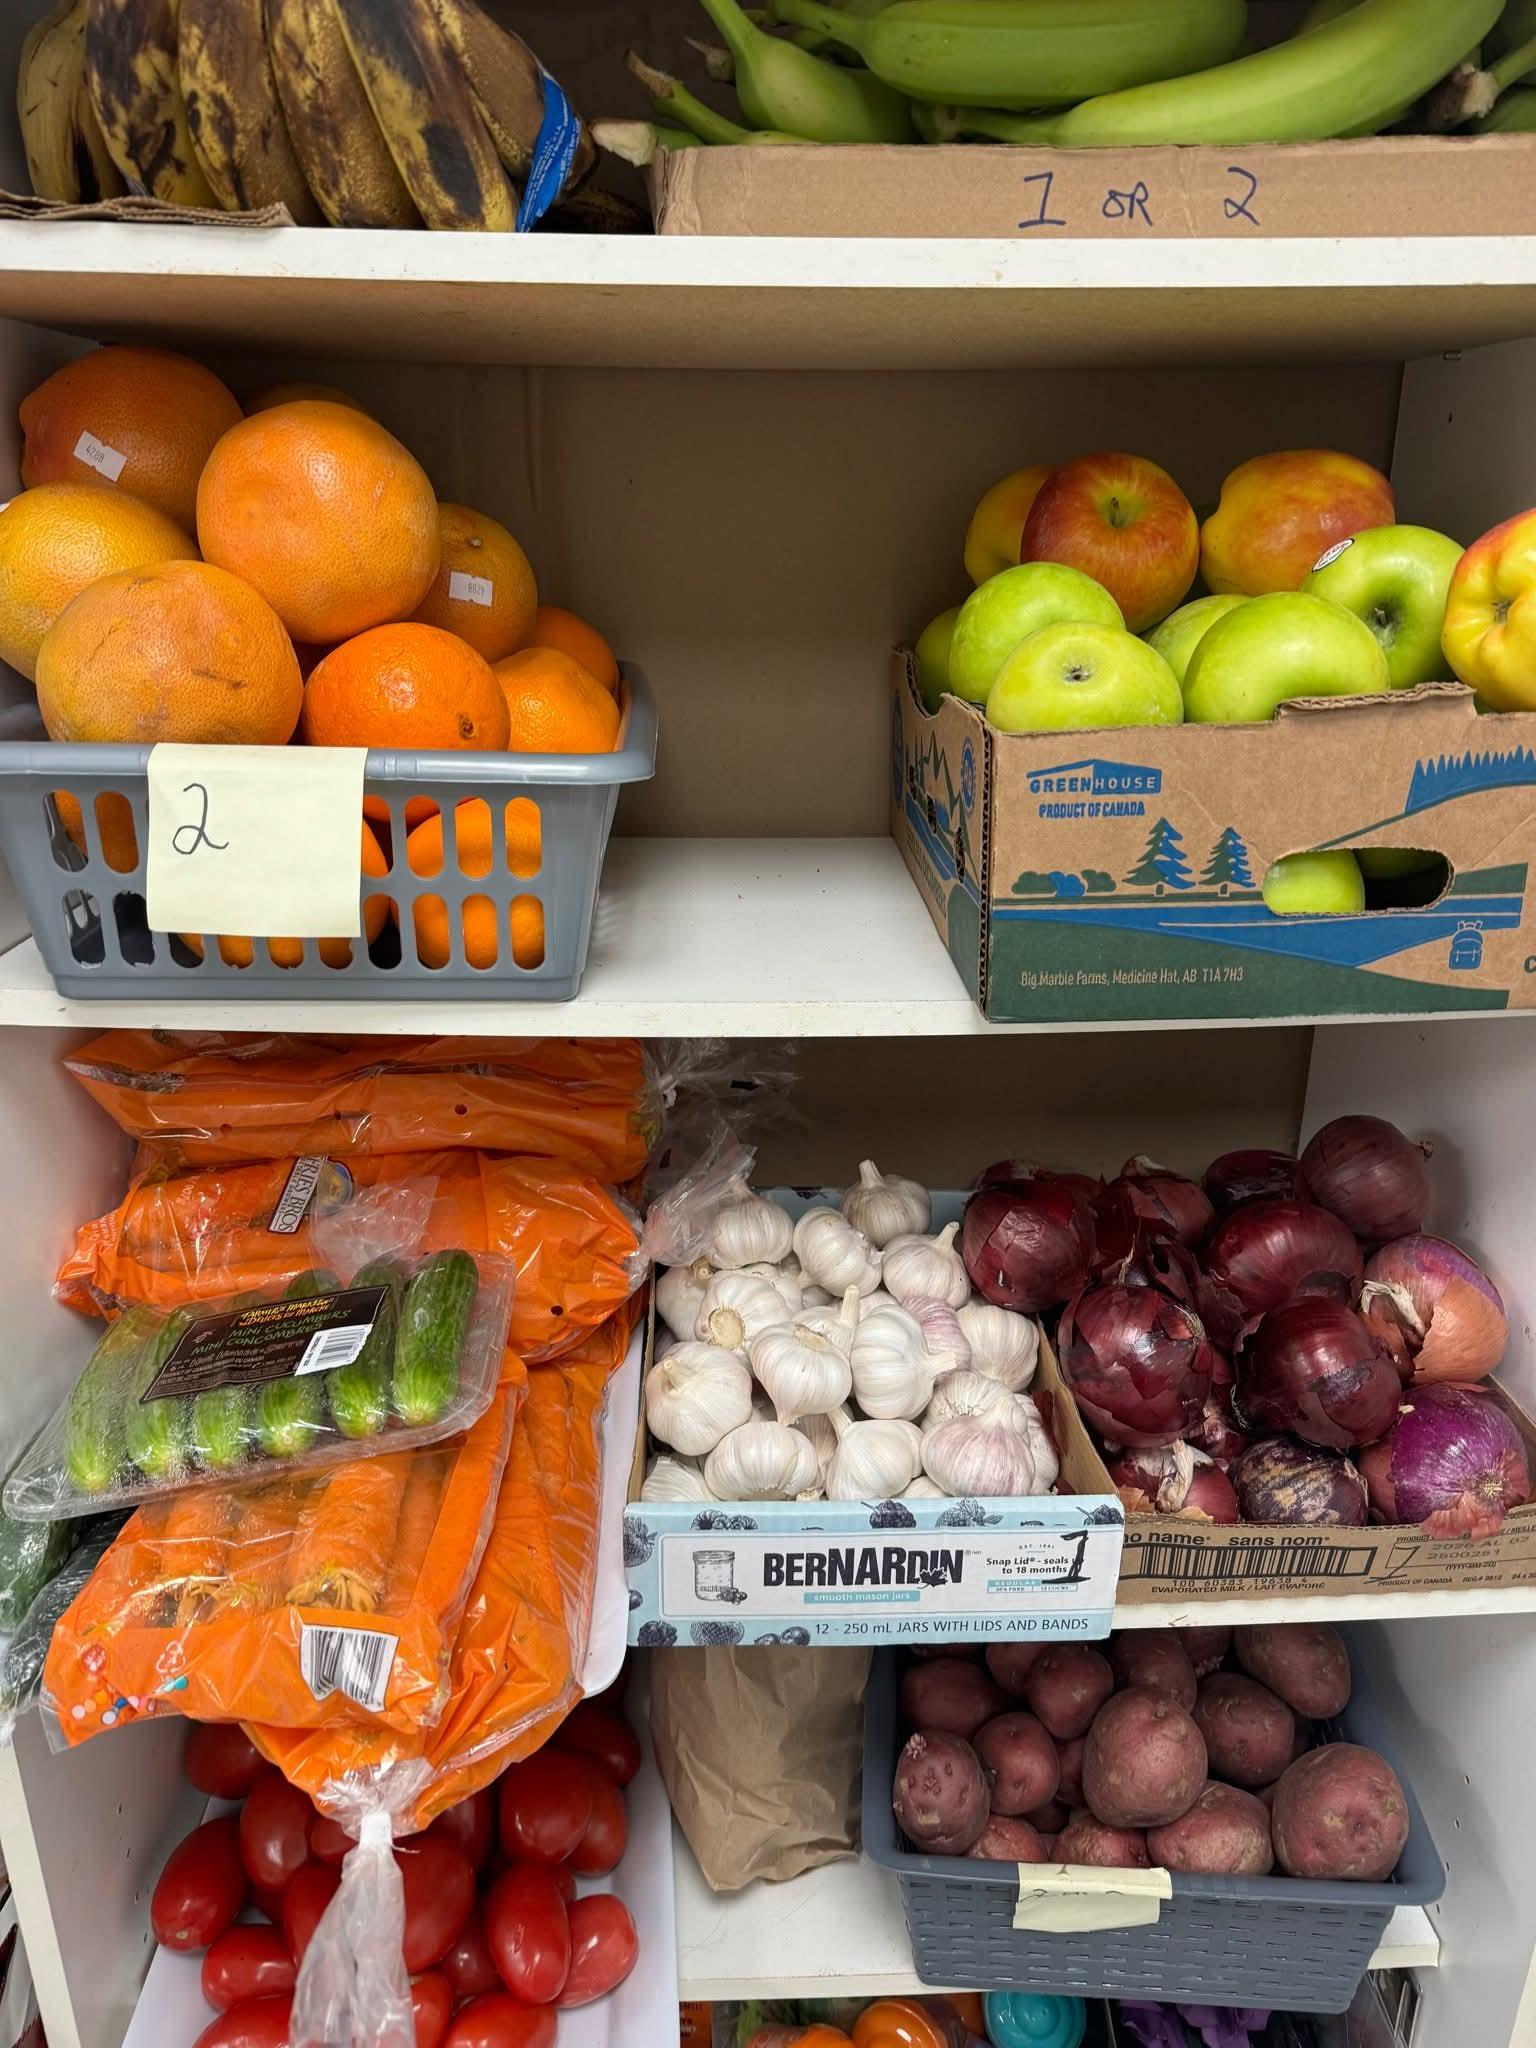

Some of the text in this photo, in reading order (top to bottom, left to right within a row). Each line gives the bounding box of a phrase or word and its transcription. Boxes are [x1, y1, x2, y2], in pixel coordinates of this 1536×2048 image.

[1018, 166, 1261, 229] 1 OR 2
[1038, 800, 1146, 818] PRODUCT OF CANADA
[172, 782, 230, 855] 2
[1020, 966, 1243, 989] Big Marble Farms, Medicine Hat, AB T1A 7H3
[278, 1196, 306, 1231] BROS
[228, 1310, 348, 1338] MINI CUCUMBERS
[191, 1323, 322, 1356] MINI CONCOMBRES
[1229, 1536, 1275, 1546] sans
[763, 1547, 964, 1587] BERNARDIN
[986, 1557, 1012, 1568] Snap
[1044, 1556, 1069, 1565] seals
[1002, 1565, 1068, 1575] to 18 months
[1151, 1585, 1217, 1594] EVAPORATED
[1219, 1584, 1245, 1593] MILK
[1424, 1577, 1453, 1585] CANADA
[813, 1593, 853, 1601] smooth
[891, 1592, 912, 1601] jars
[815, 1623, 830, 1634] 12
[844, 1623, 869, 1634] 250
[873, 1623, 892, 1634] mL
[896, 1621, 929, 1634] JARS
[933, 1620, 969, 1632] WITH
[973, 1620, 1002, 1632] LIDS
[1006, 1619, 1038, 1631] AND
[1041, 1618, 1089, 1631] BANDS
